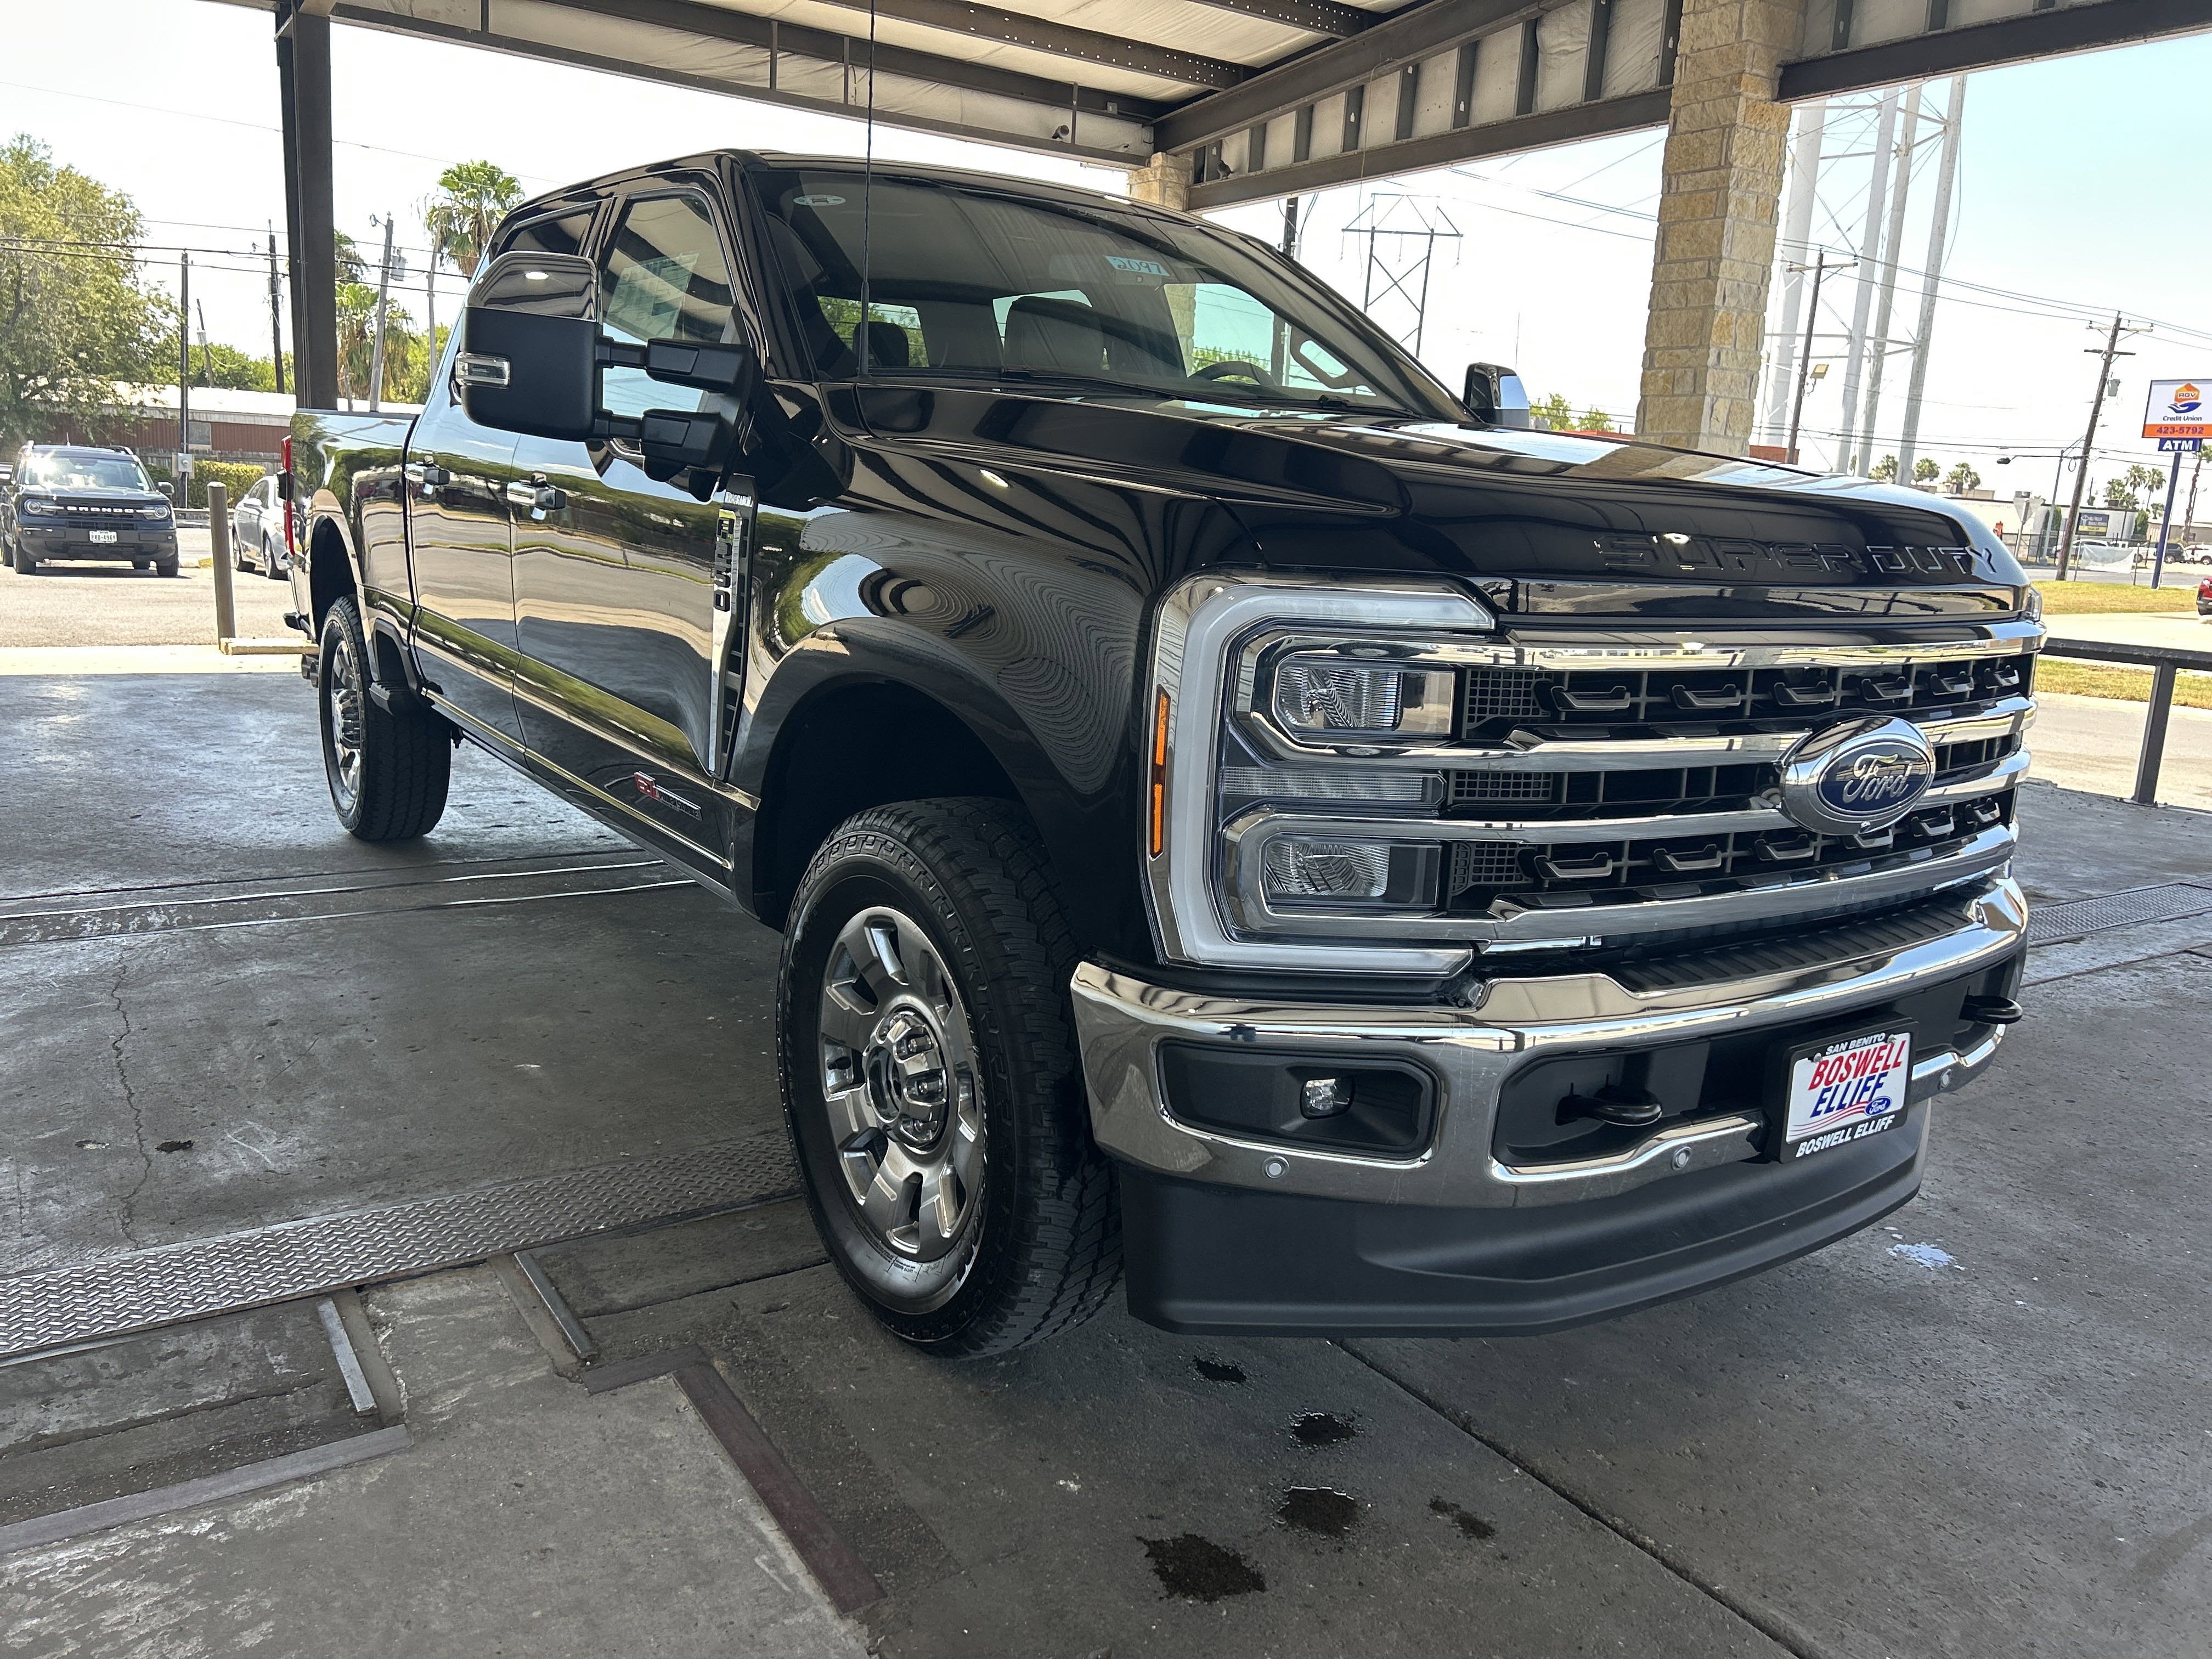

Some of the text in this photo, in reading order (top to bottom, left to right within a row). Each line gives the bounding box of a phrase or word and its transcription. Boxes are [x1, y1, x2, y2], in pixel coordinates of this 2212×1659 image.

[1113, 258, 1162, 274] 2097
[2162, 440, 2193, 450] ATM
[1593, 534, 1997, 574] SUPER DUTY
[1842, 753, 1913, 804] Ford
[1825, 1033, 1886, 1055] SAN BENITO
[1808, 1040, 1906, 1090] BOSWELL
[1810, 1071, 1888, 1118] ELLIFF
[1796, 1115, 1895, 1158] BOSWELL ELLIFF
